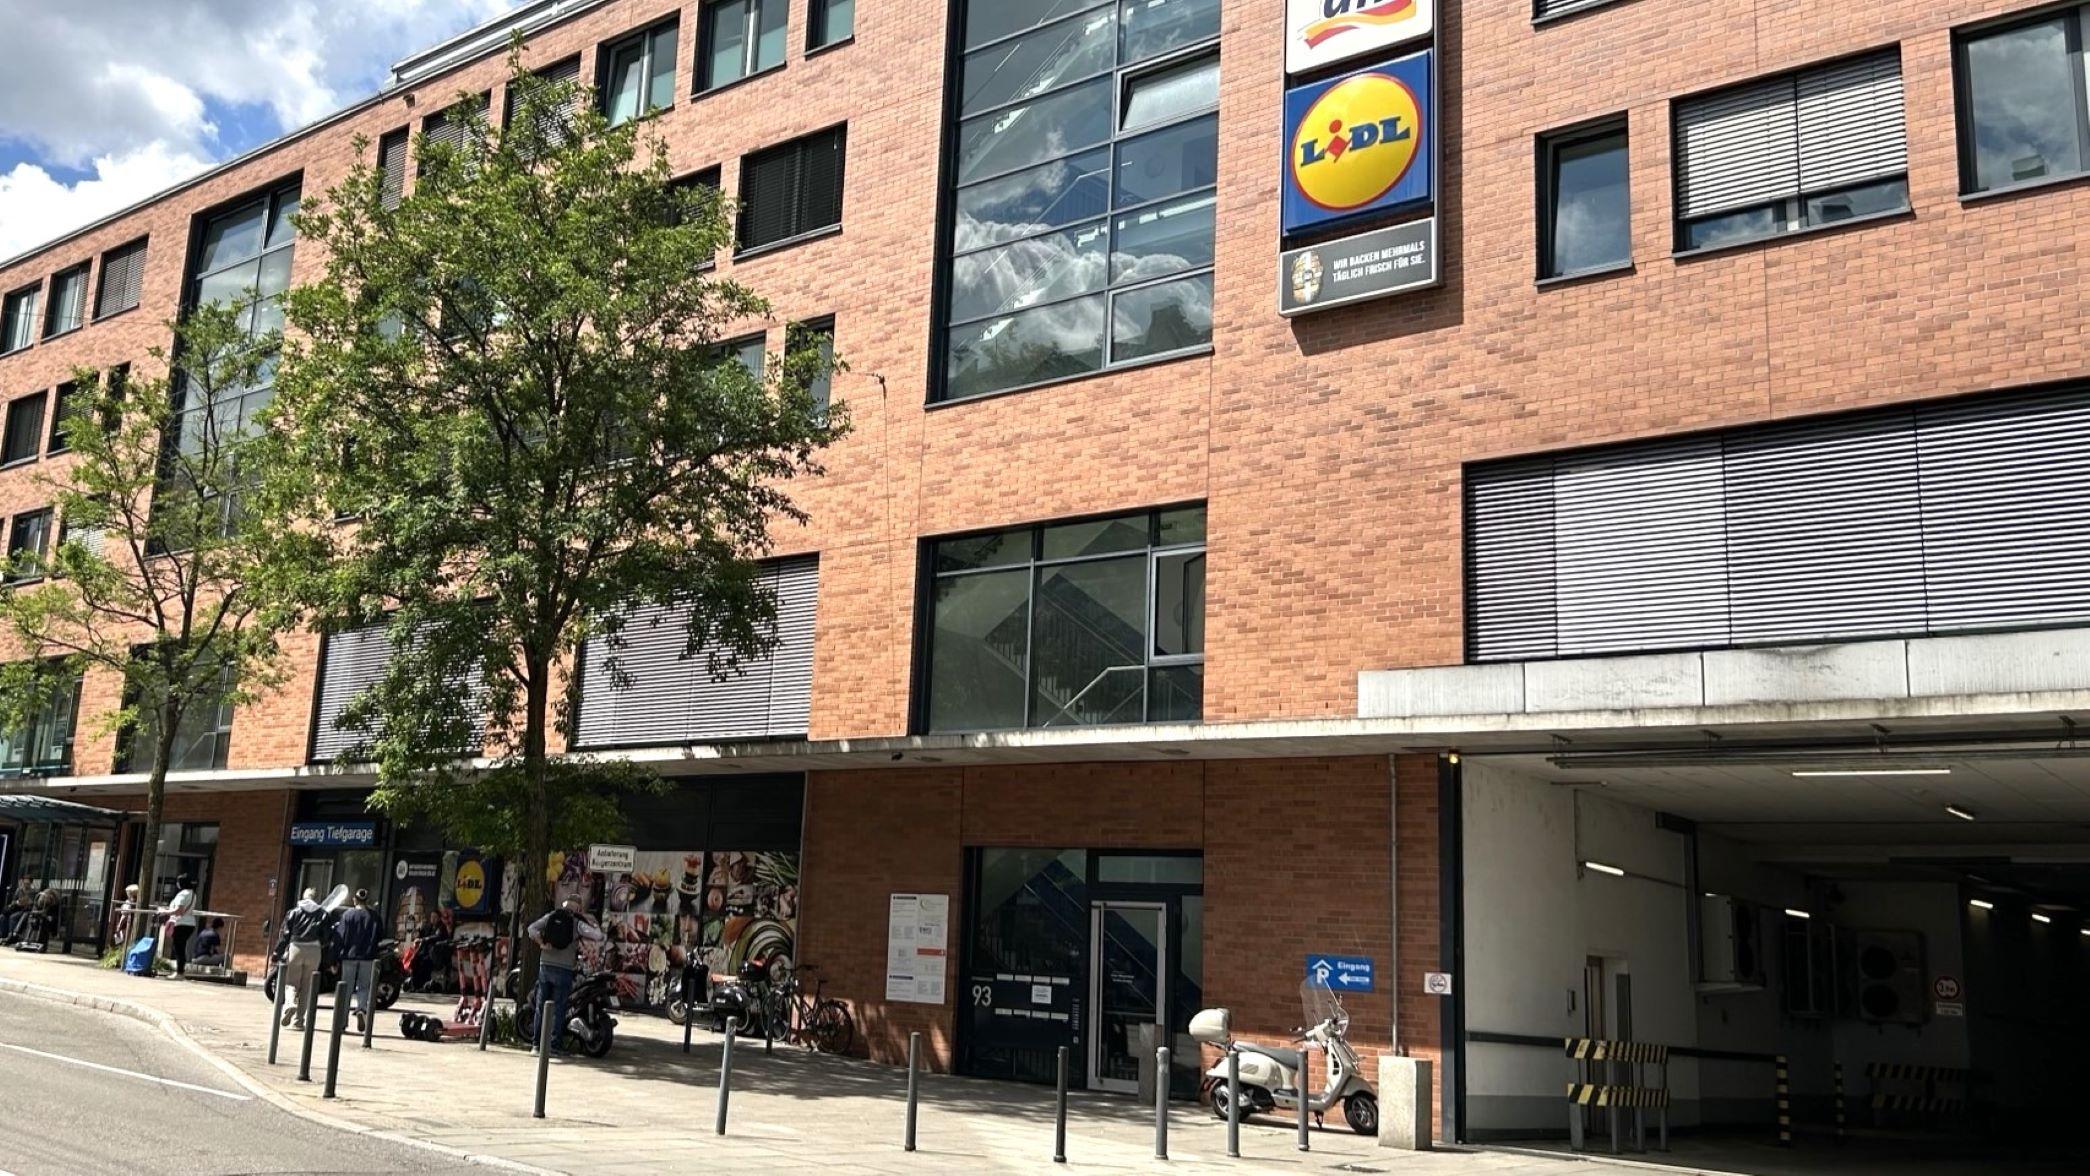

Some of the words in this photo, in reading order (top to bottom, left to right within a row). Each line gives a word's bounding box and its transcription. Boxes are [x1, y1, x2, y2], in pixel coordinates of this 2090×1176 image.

[1333, 257, 1348, 270] WIR
[1349, 250, 1380, 267] BACKEN
[1381, 240, 1426, 259] MEHRMALS
[1332, 267, 1363, 283] TÄGLICH
[1365, 260, 1392, 275] FRISCH
[1393, 256, 1409, 270] FÜR
[1410, 253, 1426, 266] SIE.
[290, 825, 325, 842] Eingang
[326, 825, 373, 842] Tiefgarage
[1337, 961, 1370, 972] Eingang
[971, 984, 992, 1007] 93
